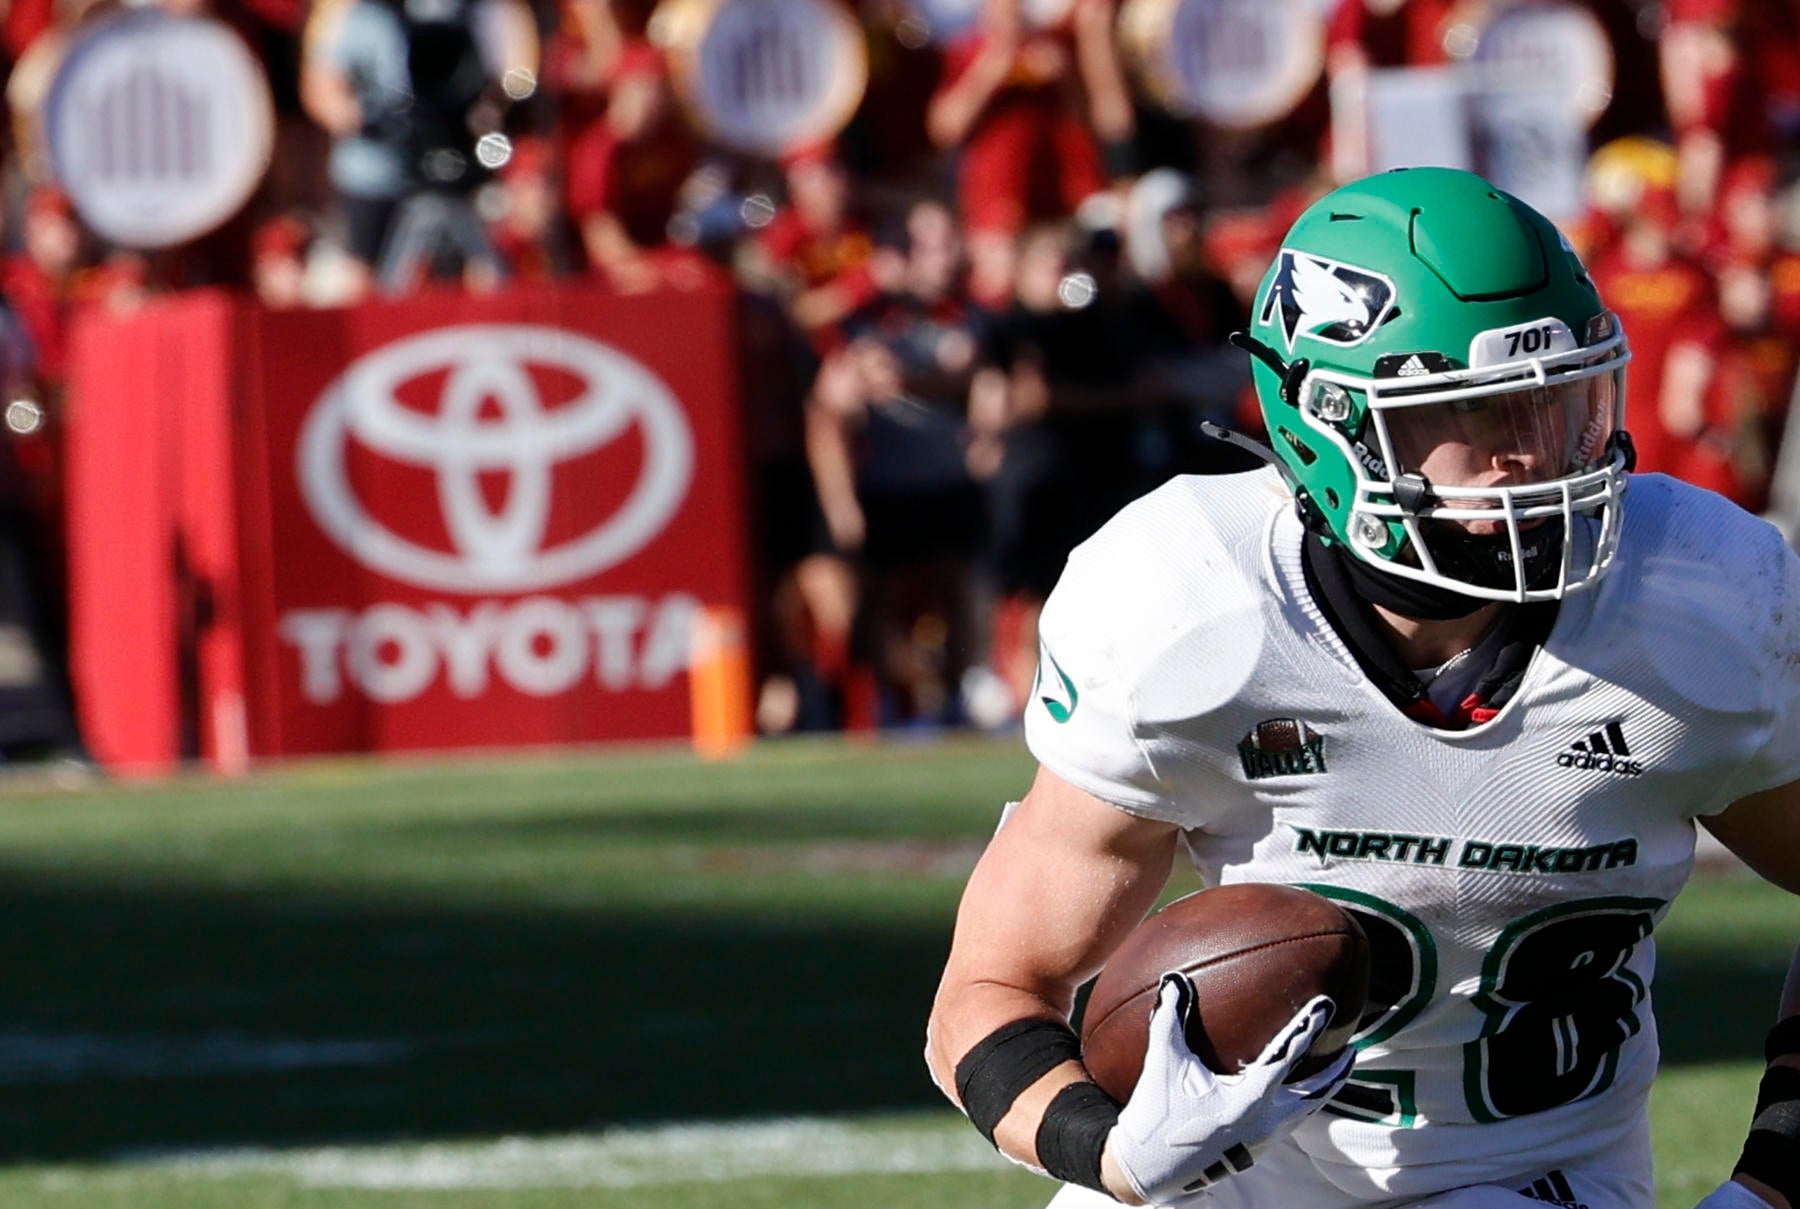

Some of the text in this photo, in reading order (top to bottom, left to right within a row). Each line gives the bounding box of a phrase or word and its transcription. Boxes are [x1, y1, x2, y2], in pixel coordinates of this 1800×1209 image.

[1505, 326, 1551, 357] 701
[280, 593, 710, 706] TOYOTA
[1238, 734, 1328, 780] VALLEY
[1556, 751, 1643, 778] adidas
[1290, 825, 1639, 874] NORTH DAKOTA
